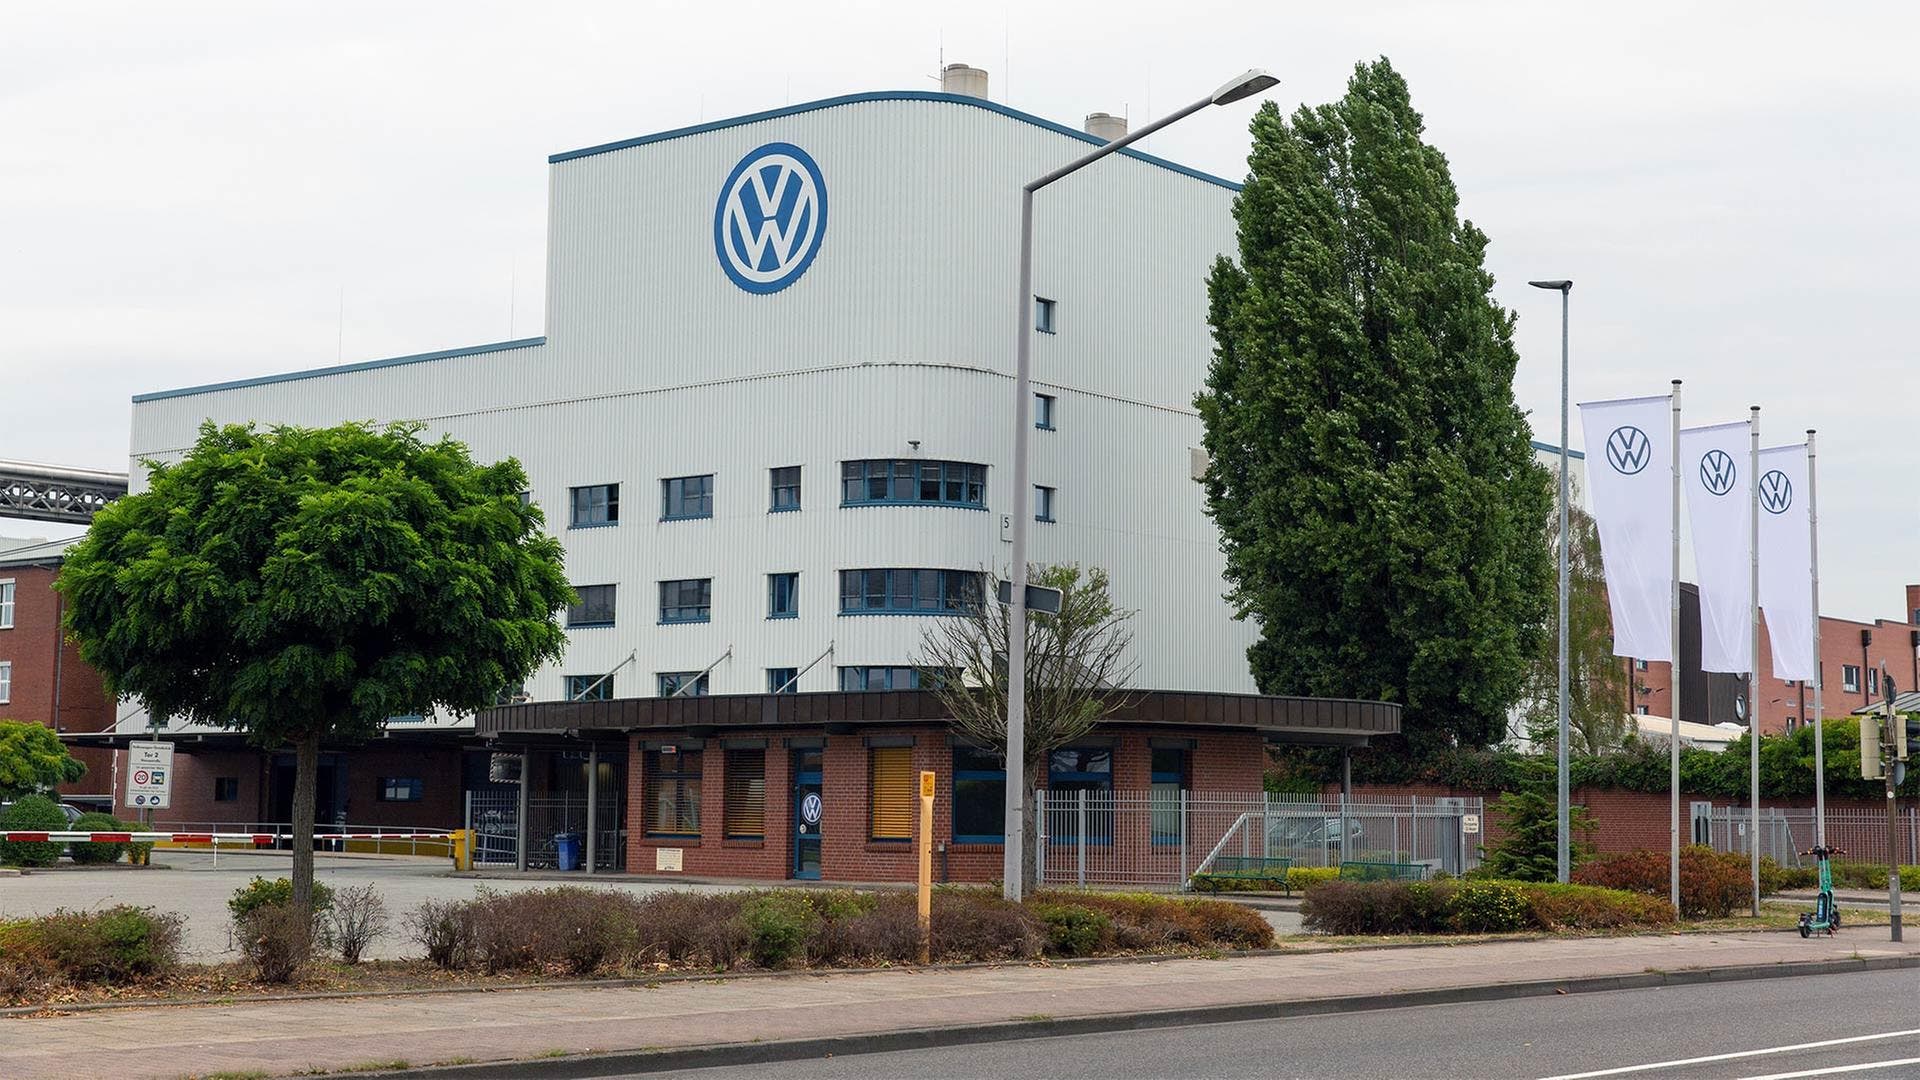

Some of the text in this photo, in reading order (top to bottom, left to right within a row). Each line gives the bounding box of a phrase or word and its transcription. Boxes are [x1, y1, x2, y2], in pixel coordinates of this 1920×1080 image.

[722, 153, 819, 283] VW
[1606, 426, 1651, 475] VW
[1700, 449, 1736, 495] VW
[1758, 470, 1792, 514] VW
[1004, 516, 1009, 528] 5
[803, 795, 822, 822] VW
